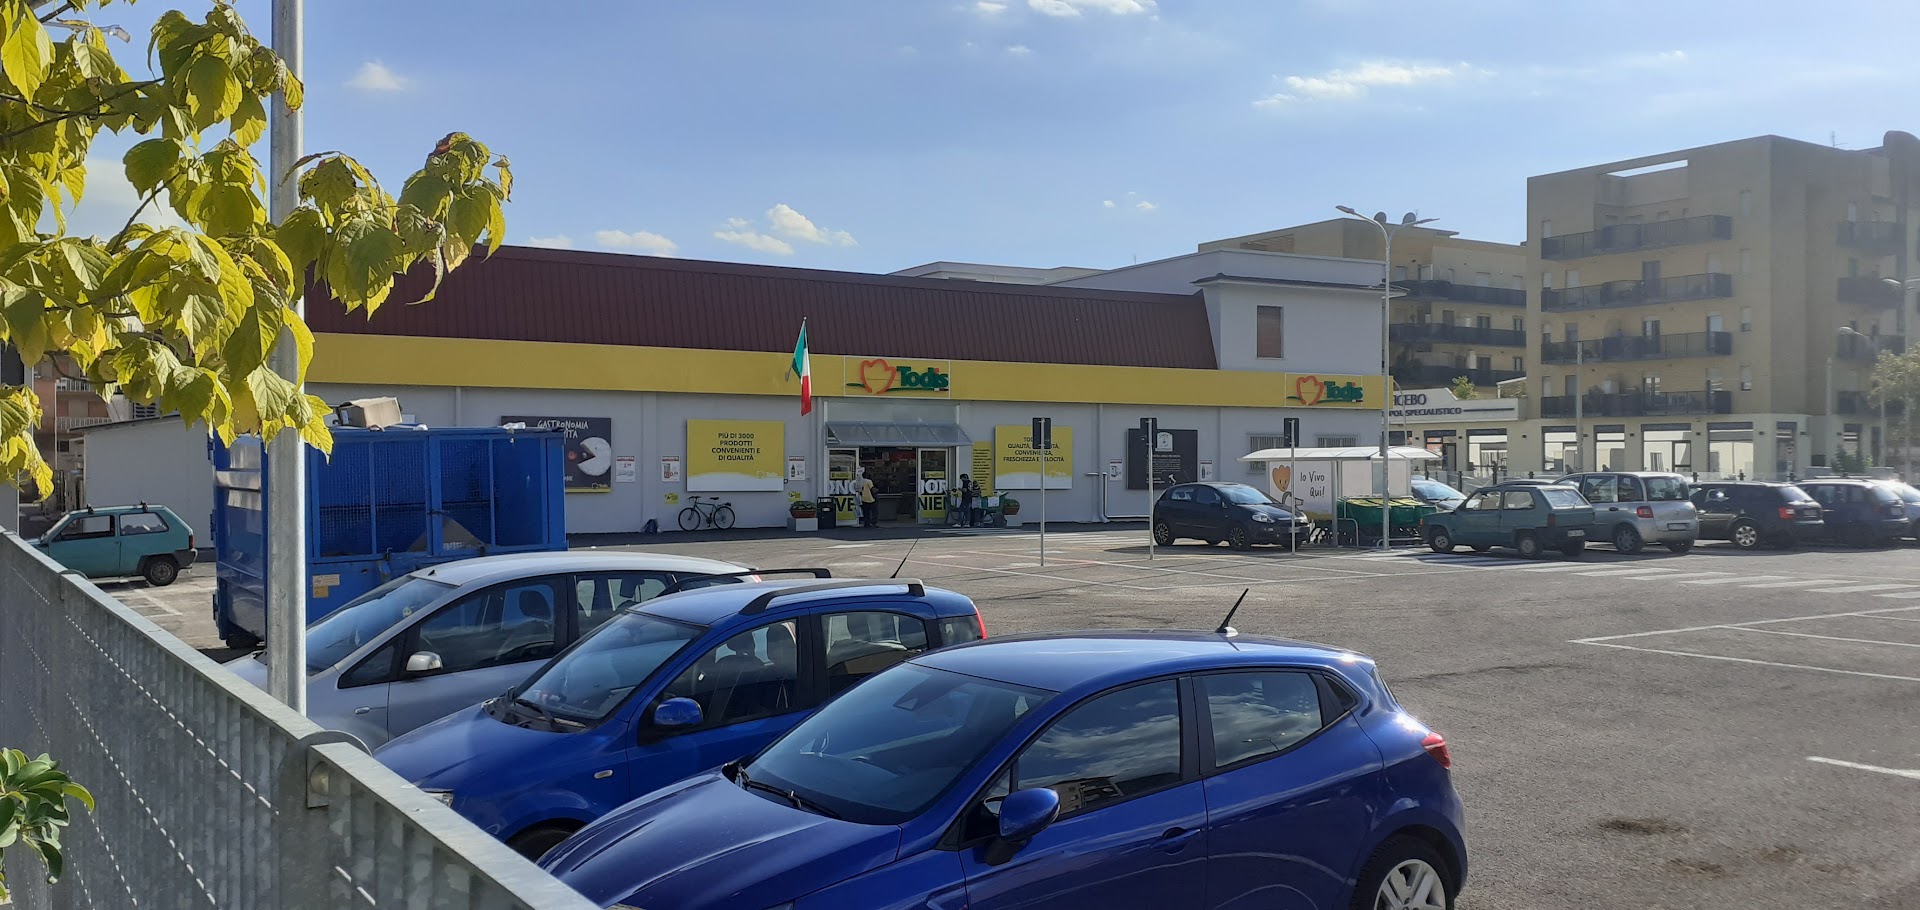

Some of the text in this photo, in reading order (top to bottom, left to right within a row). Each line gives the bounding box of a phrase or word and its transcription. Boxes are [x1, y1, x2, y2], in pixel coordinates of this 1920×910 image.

[1405, 407, 1462, 416] SPECIALISTICO
[537, 419, 589, 430] GASTRONOMIA
[718, 431, 729, 439] PIÙ
[1308, 471, 1325, 482] Vivo
[1309, 486, 1325, 498] Qui!
